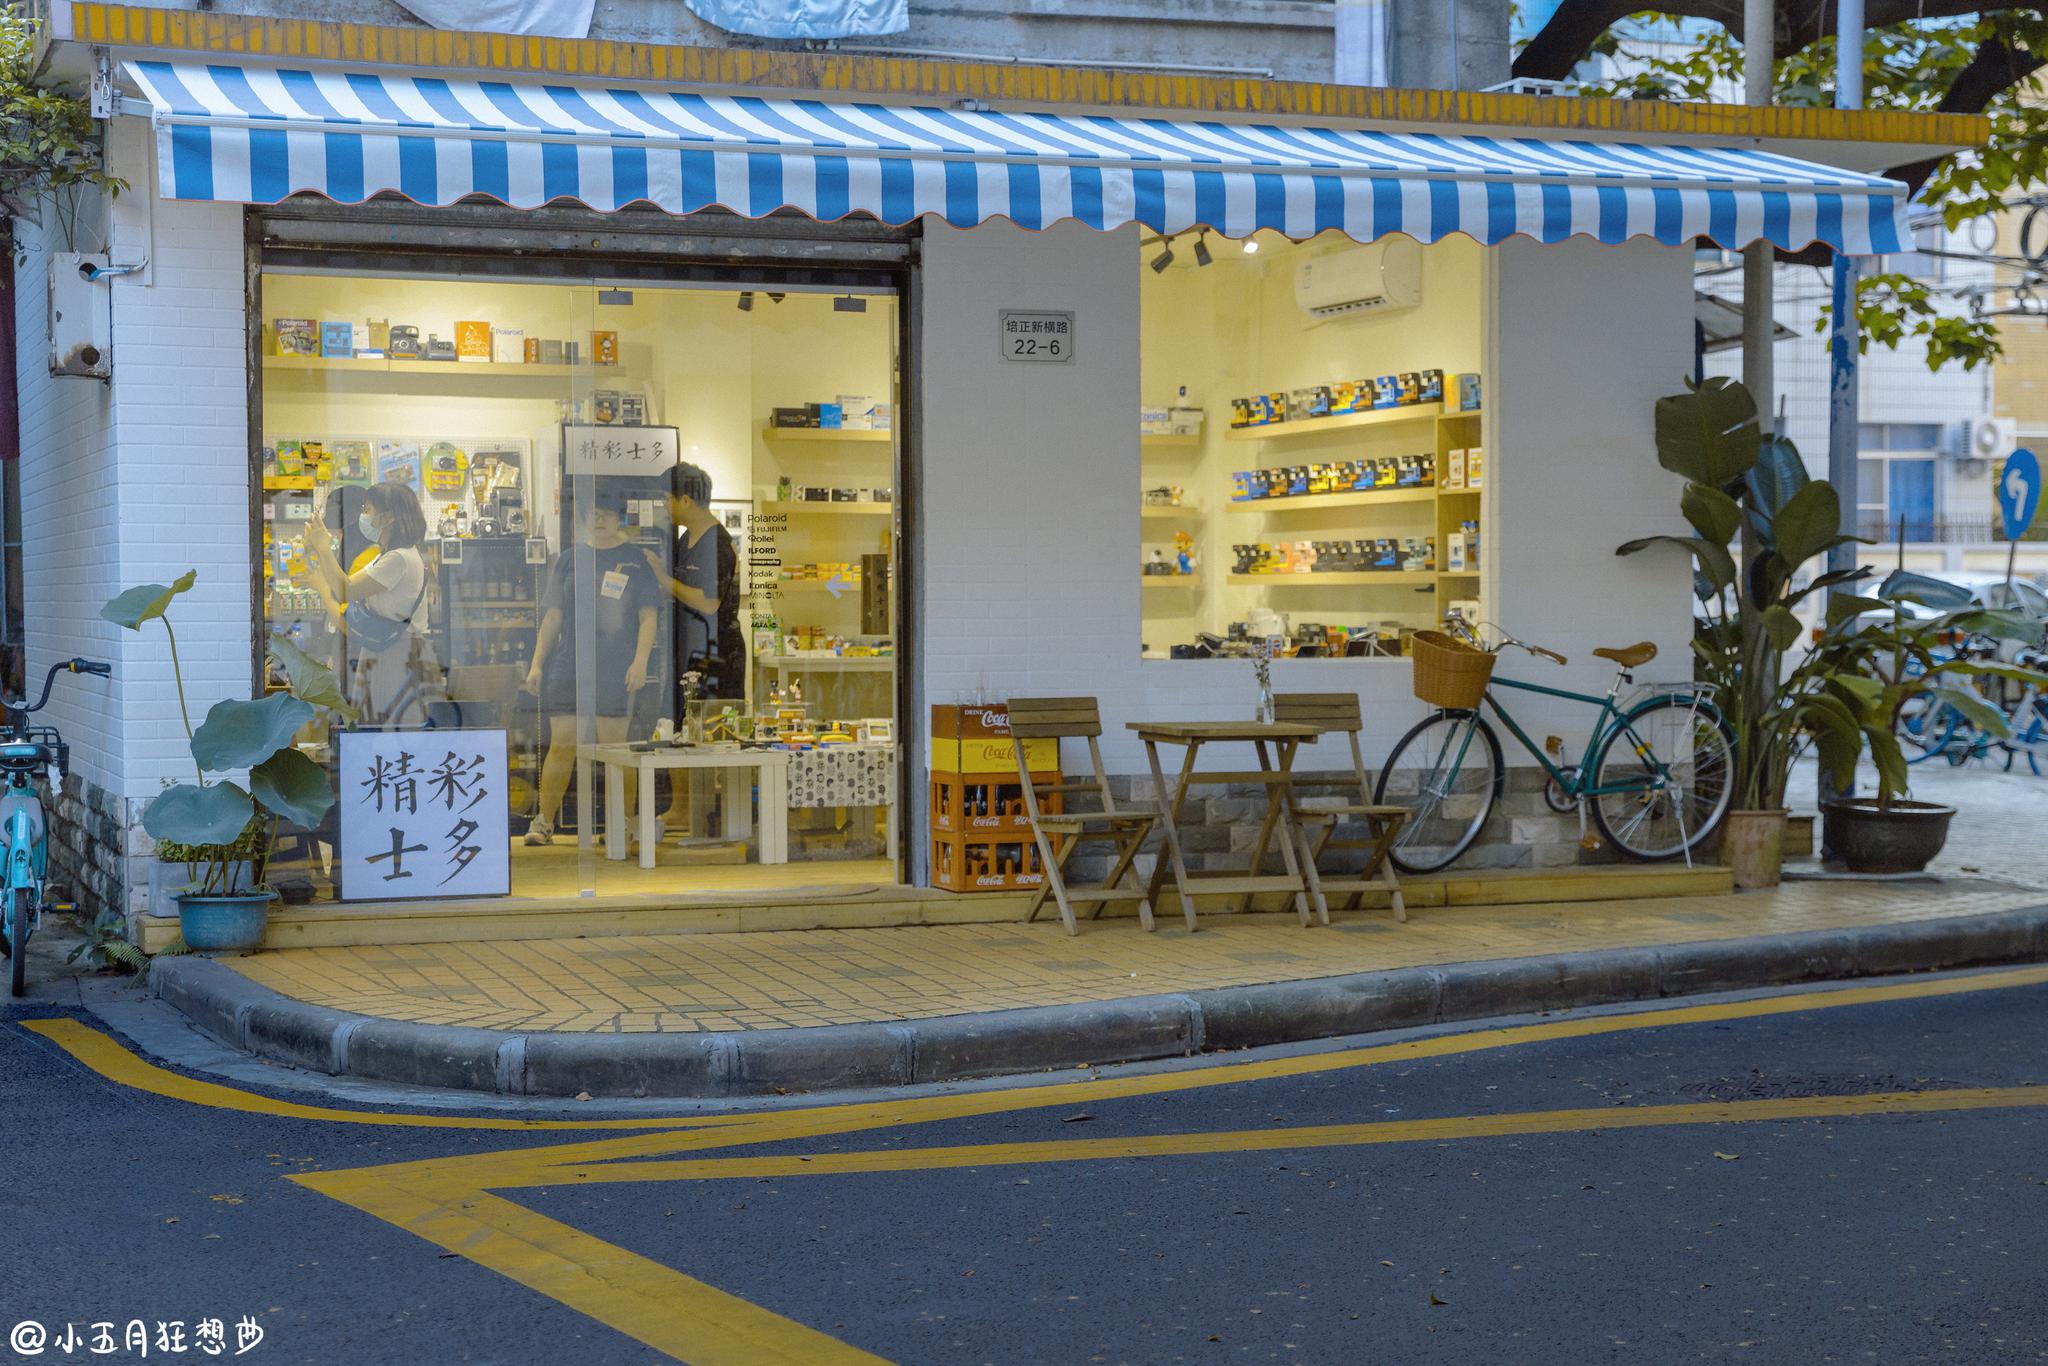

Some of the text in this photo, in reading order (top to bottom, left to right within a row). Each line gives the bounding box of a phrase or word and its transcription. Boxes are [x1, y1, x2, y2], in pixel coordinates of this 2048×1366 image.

[1006, 320, 1068, 334] 培正新横路
[1014, 339, 1060, 355] 22-6
[747, 513, 787, 523] Polaroid
[360, 751, 488, 815] 精彩
[364, 818, 482, 887] 士多
